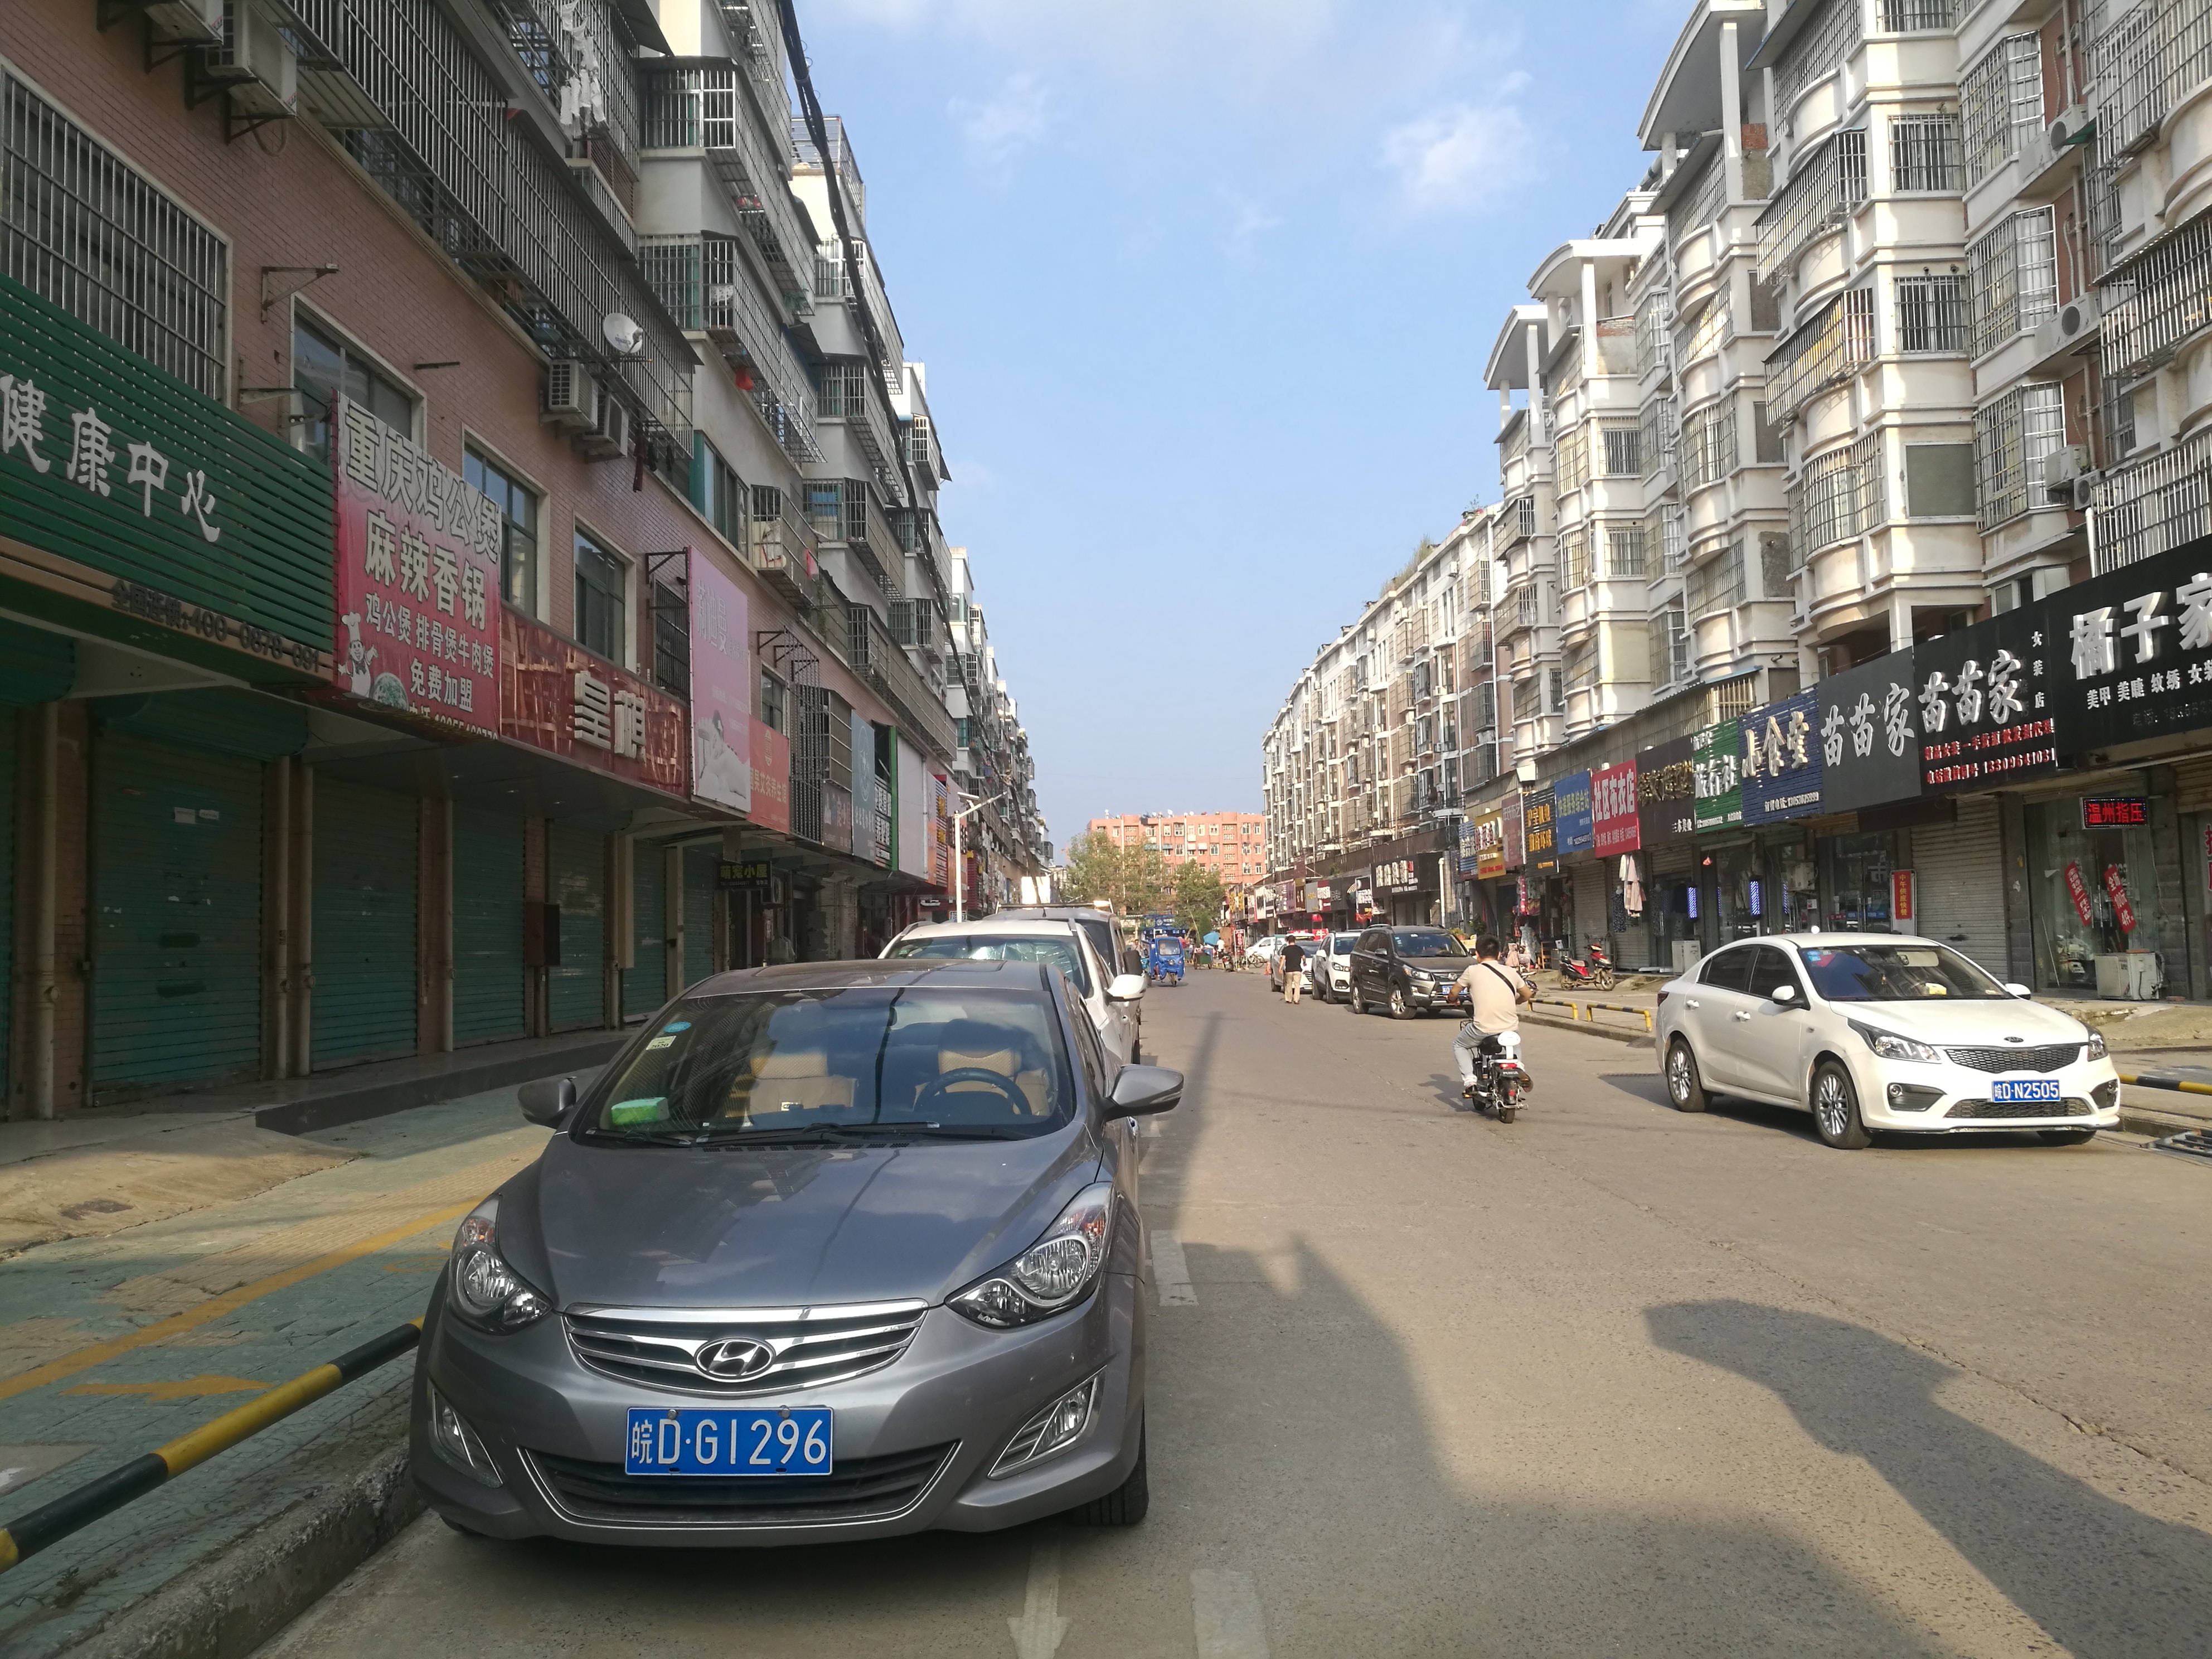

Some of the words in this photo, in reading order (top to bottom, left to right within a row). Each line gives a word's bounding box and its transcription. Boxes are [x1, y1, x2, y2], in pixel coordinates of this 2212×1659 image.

[0, 374, 220, 542] 健康中心
[345, 406, 501, 564] 重庆鸡公煲
[365, 509, 486, 631] 麻辣香锅
[366, 592, 411, 646] 鸡公煲
[410, 657, 473, 713] 免费加盟
[1918, 649, 2023, 733] 苗苗家
[2031, 631, 2045, 709] 女装店
[2087, 686, 2111, 710] 美甲
[2151, 669, 2181, 693] 纹绣
[1821, 682, 1914, 767] 苗苗家
[1594, 769, 1636, 822] 社区布衣店
[2088, 802, 2145, 823] 温州指压
[1995, 1082, 2058, 1100] 皖D·N2505
[632, 1419, 828, 1465] 皖D·G1296
